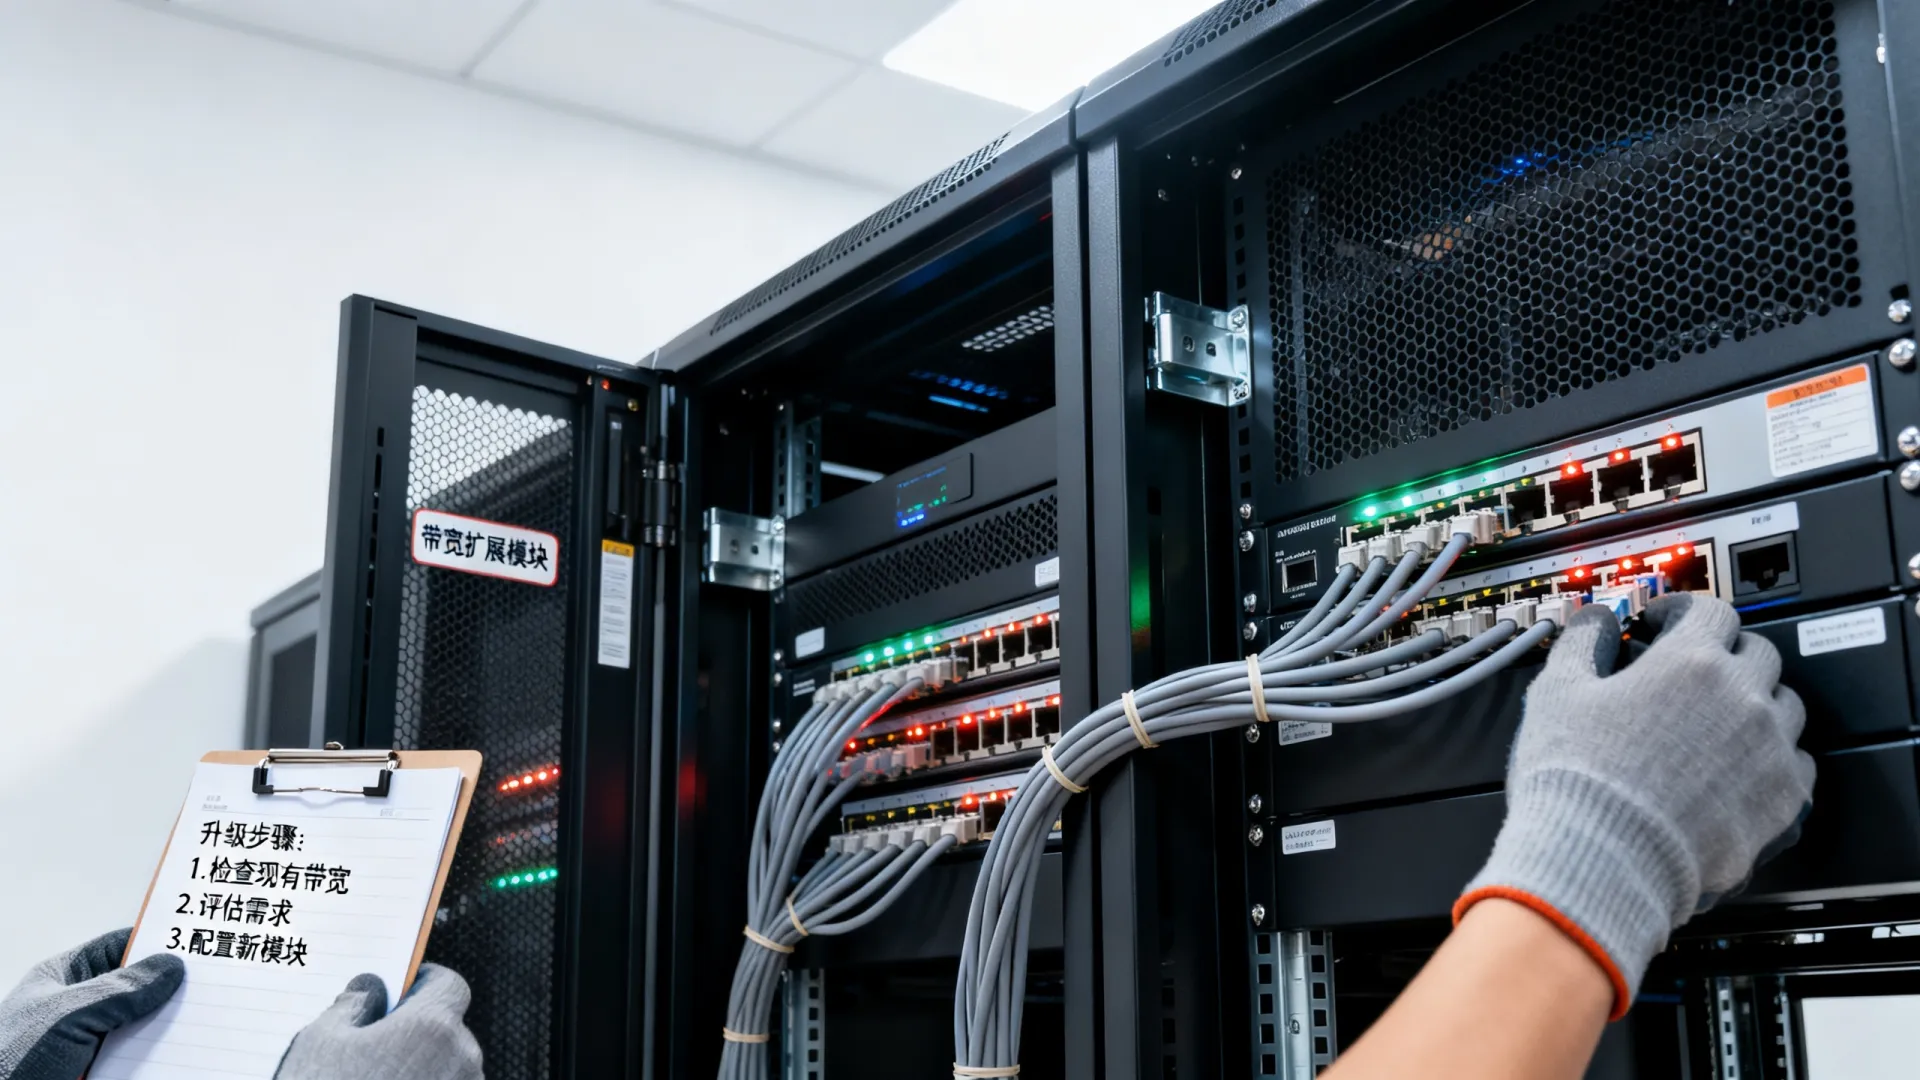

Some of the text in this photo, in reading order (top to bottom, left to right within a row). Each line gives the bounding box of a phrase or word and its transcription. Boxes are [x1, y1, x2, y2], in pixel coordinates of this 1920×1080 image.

[421, 524, 549, 571] 带宽扩展模块
[191, 856, 351, 895] 1.检查现有带宽
[175, 893, 293, 927] 2.评估需求
[166, 927, 308, 967] 3.配置新模块
